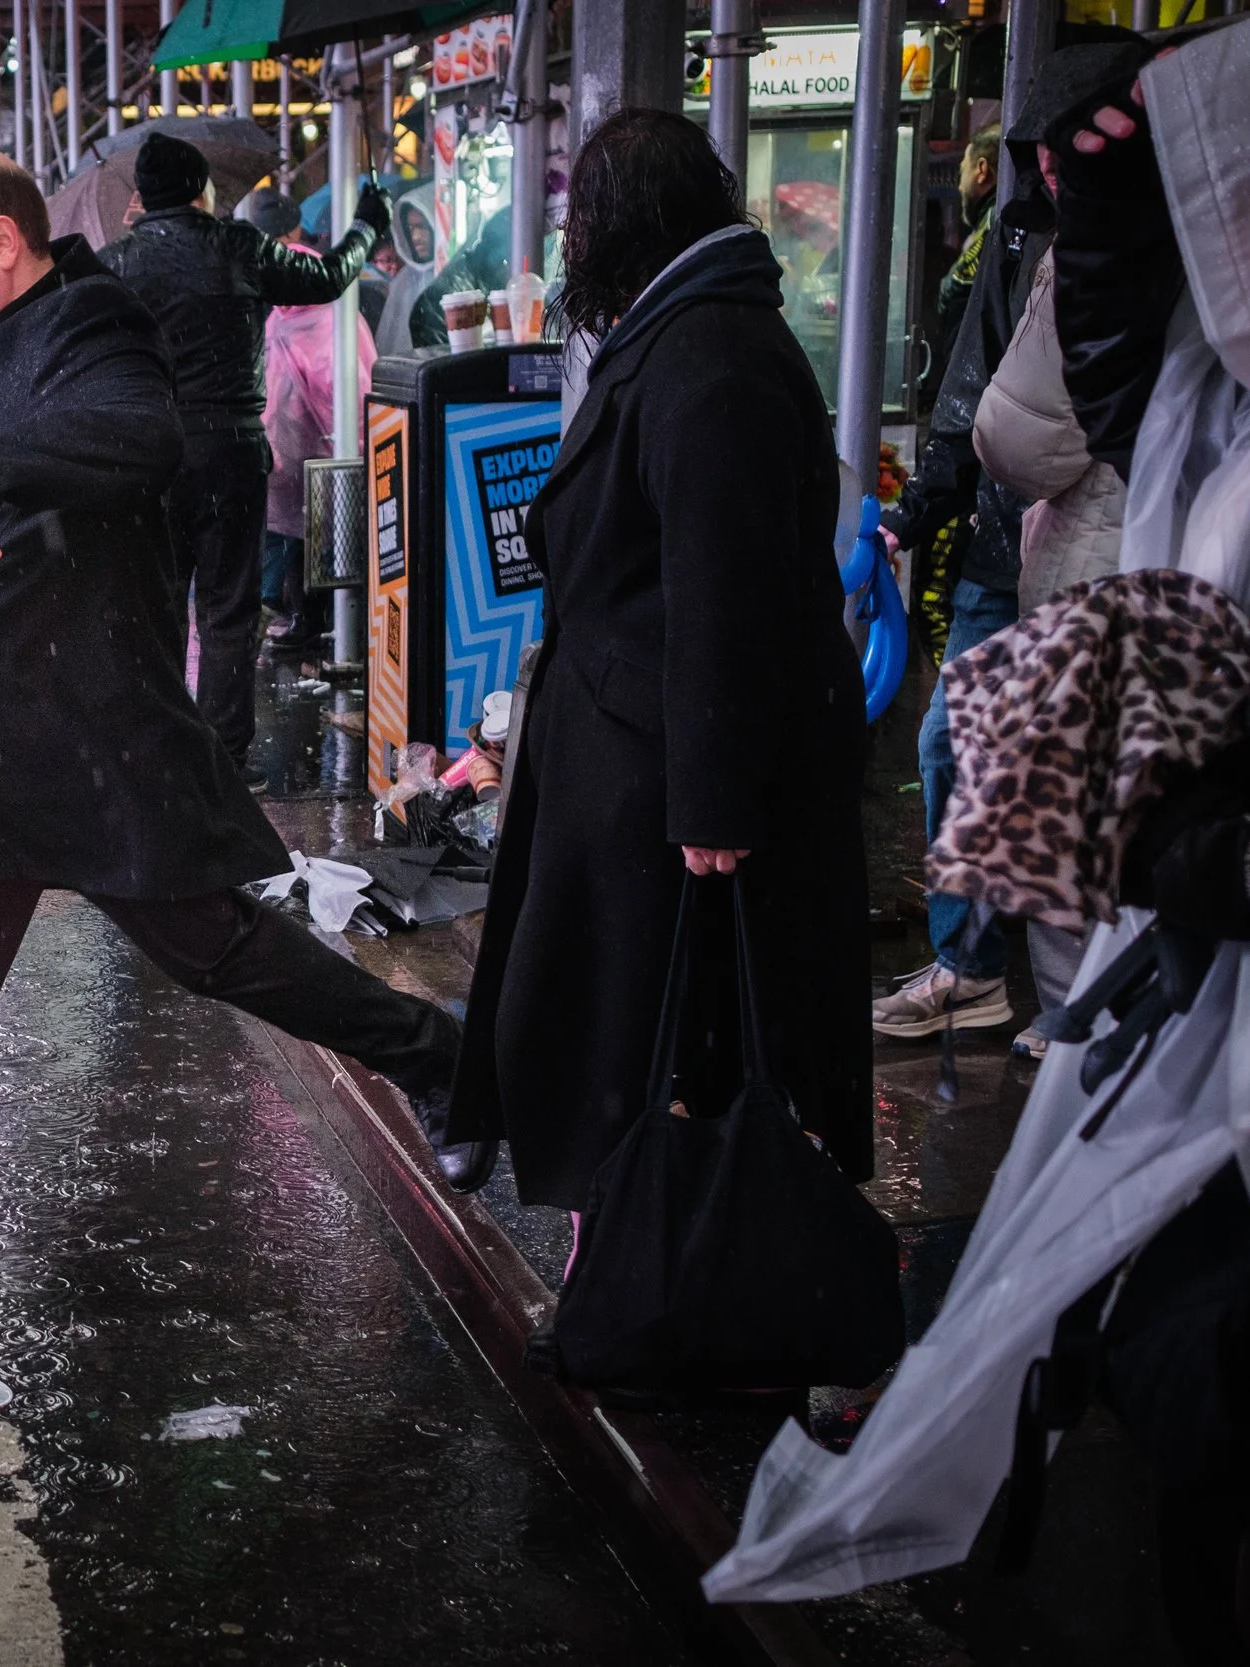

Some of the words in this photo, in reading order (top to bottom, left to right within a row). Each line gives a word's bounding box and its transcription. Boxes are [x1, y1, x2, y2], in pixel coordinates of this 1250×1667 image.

[750, 79, 800, 95] HALAL
[805, 76, 850, 94] FOOD
[490, 508, 518, 537] IN
[499, 563, 533, 577] DISCOVER
